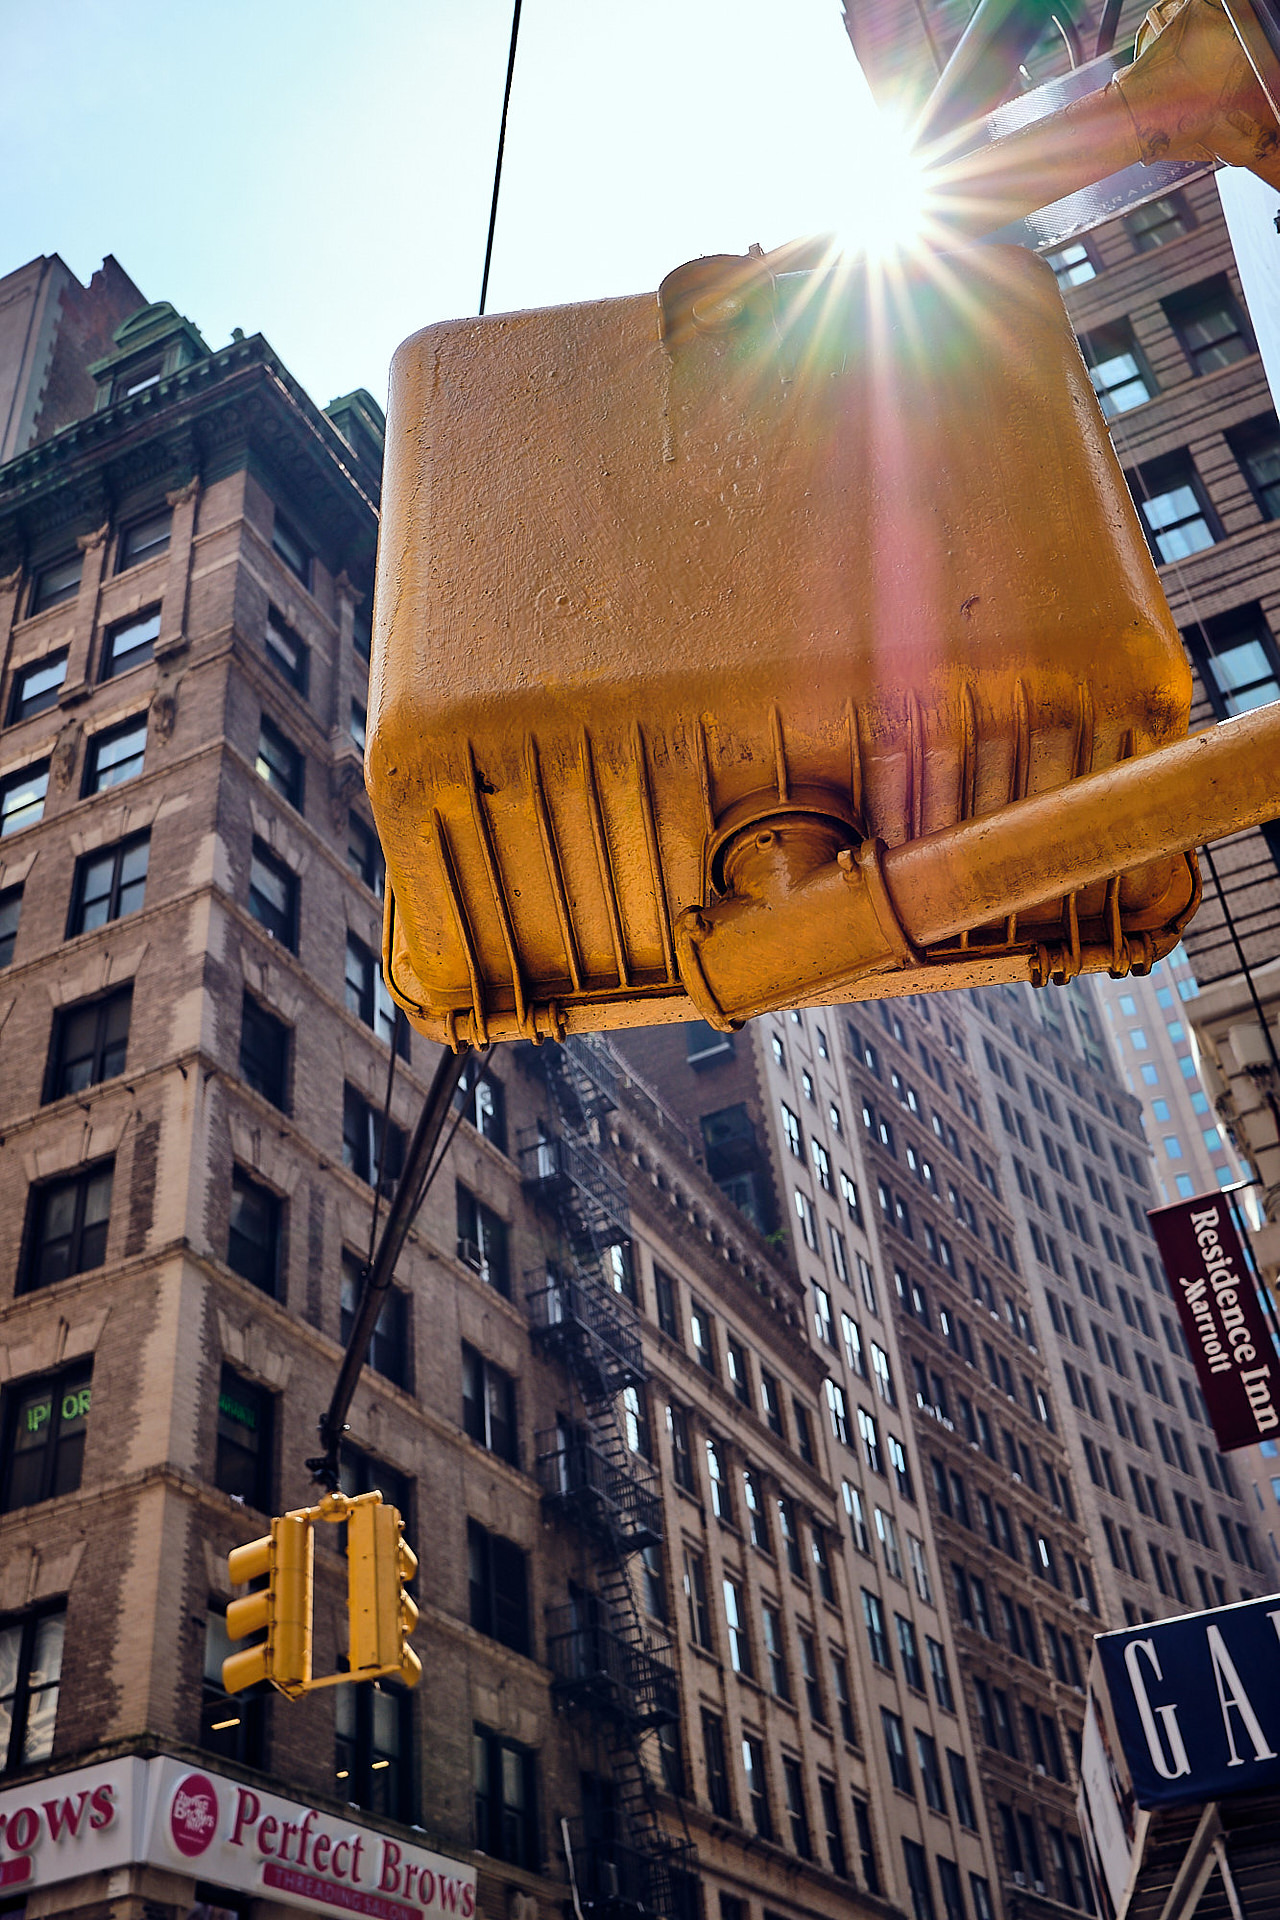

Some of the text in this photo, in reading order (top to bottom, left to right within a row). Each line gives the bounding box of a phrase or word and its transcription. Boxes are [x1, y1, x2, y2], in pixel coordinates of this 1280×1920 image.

[1178, 1276, 1233, 1375] Marriott
[1190, 1205, 1280, 1434] Residence Inn
[1124, 1610, 1280, 1779] GA
[229, 1787, 475, 1918] Perfect Brows
[275, 1867, 410, 1920] THREADING SALON
